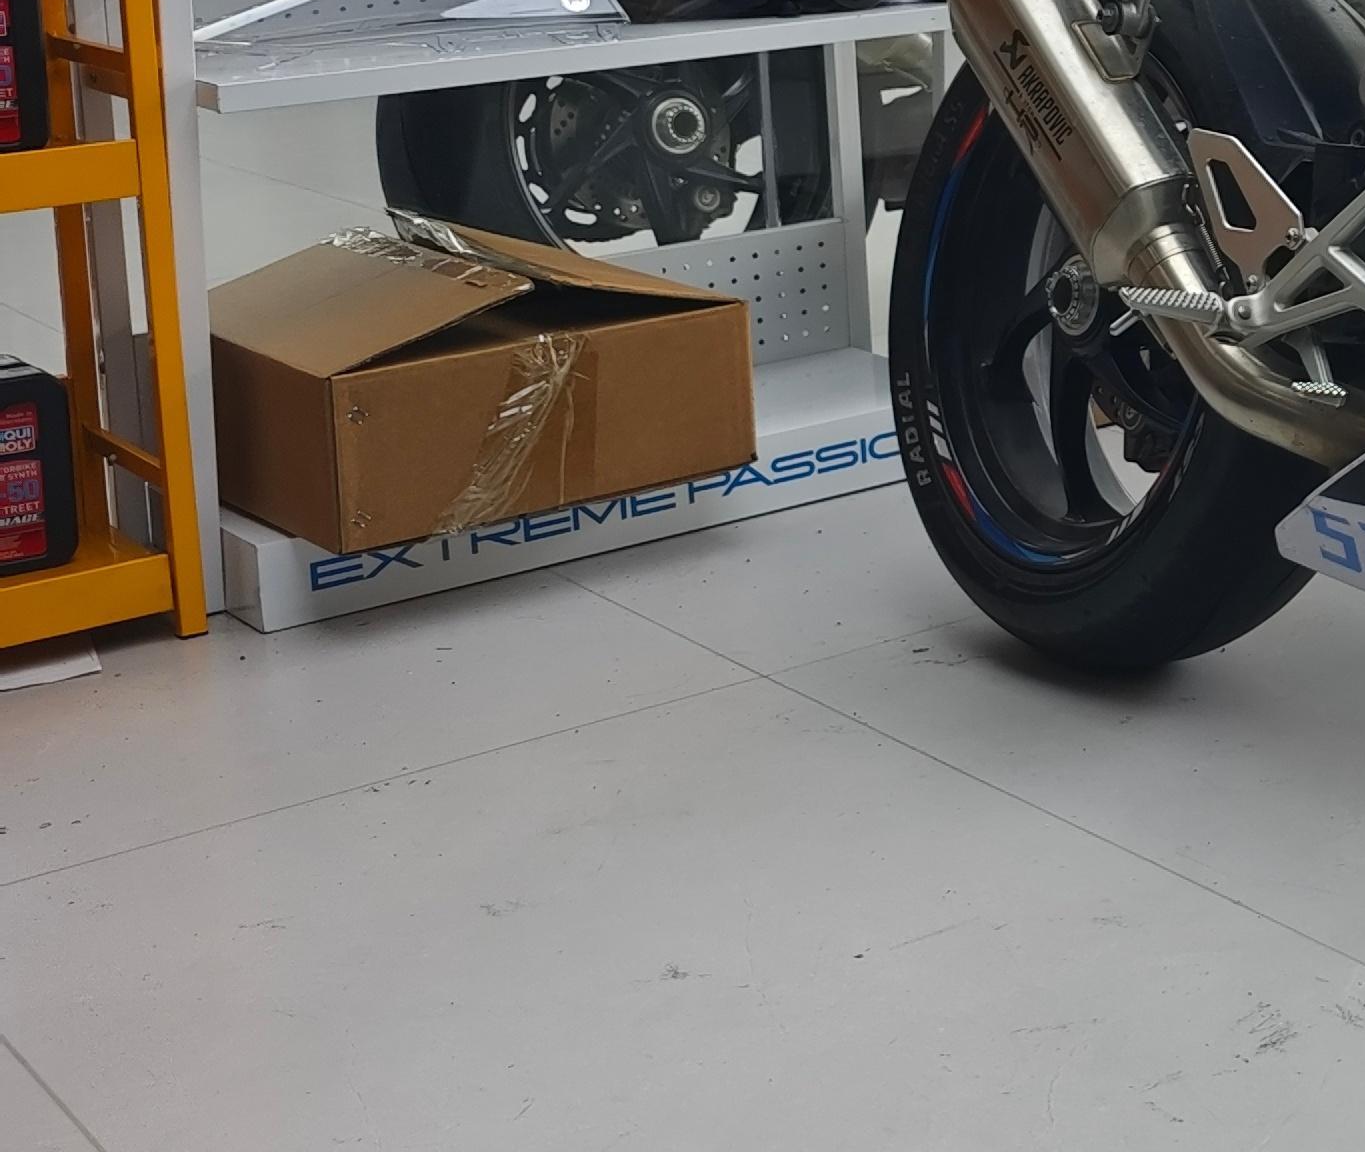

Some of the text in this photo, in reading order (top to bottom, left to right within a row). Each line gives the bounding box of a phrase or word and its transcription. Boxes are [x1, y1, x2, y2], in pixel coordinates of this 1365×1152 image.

[1017, 65, 1074, 146] AKRAPOVIC
[0, 428, 31, 441] QUI
[898, 371, 931, 488] RADIAL
[685, 431, 903, 495] PASSIO
[0, 502, 40, 516] TREET
